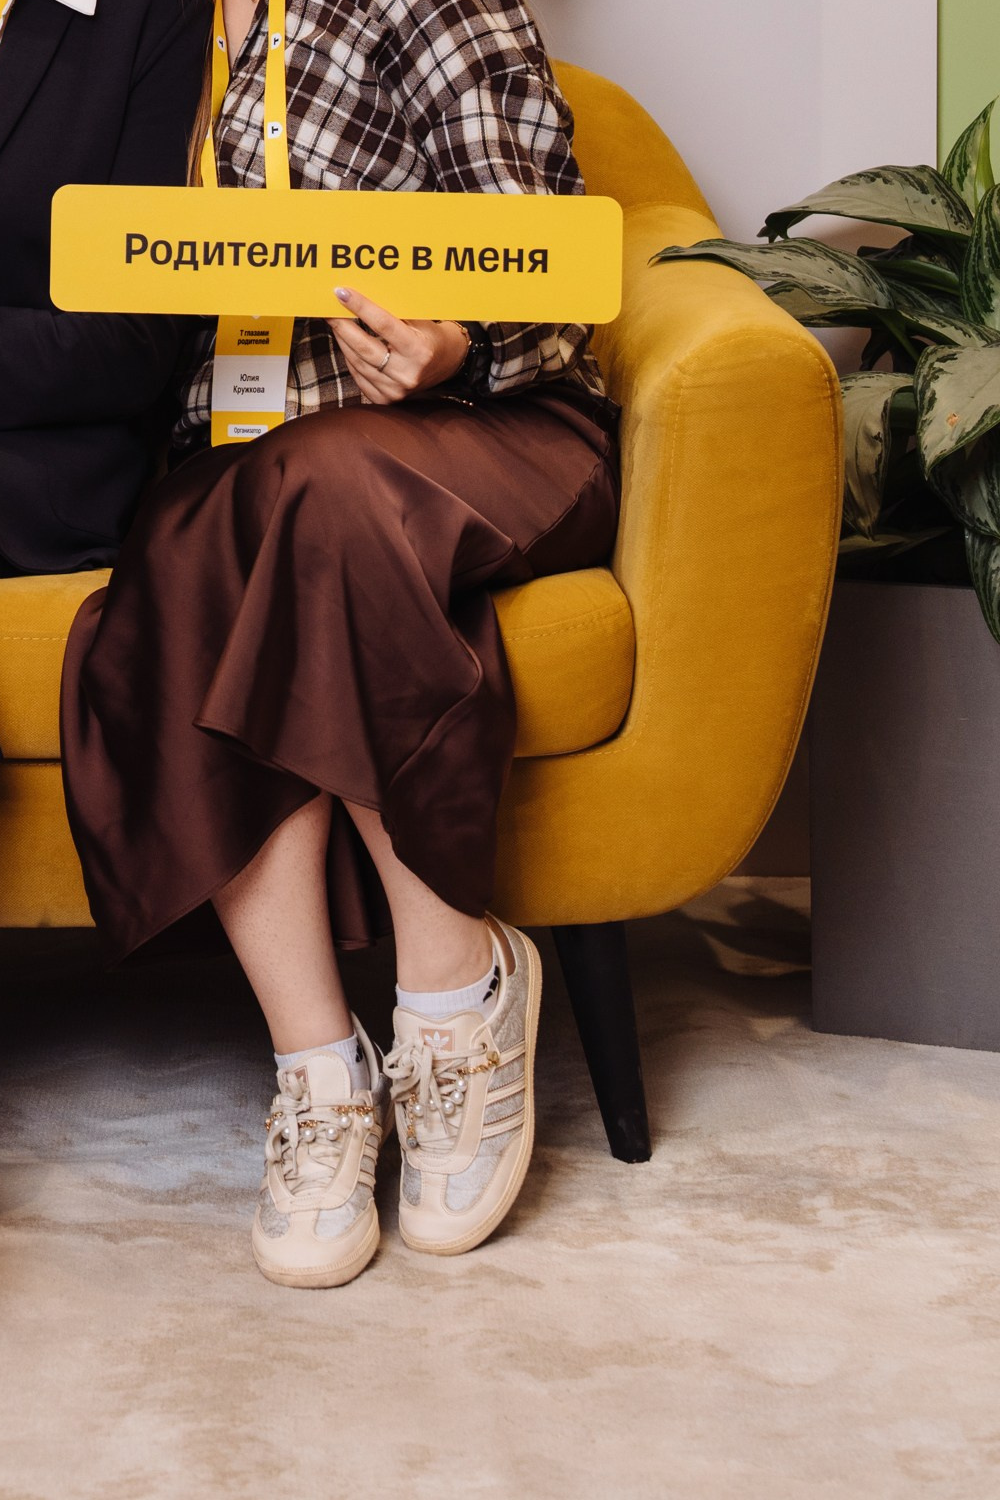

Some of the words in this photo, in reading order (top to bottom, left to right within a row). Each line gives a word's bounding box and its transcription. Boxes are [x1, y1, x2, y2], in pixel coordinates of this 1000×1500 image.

[125, 233, 318, 271] Родители
[331, 244, 400, 271] все
[412, 246, 433, 271] в
[444, 246, 549, 274] меня
[245, 329, 270, 337] глазами
[237, 338, 270, 346] родителей
[240, 373, 260, 382] Юлия
